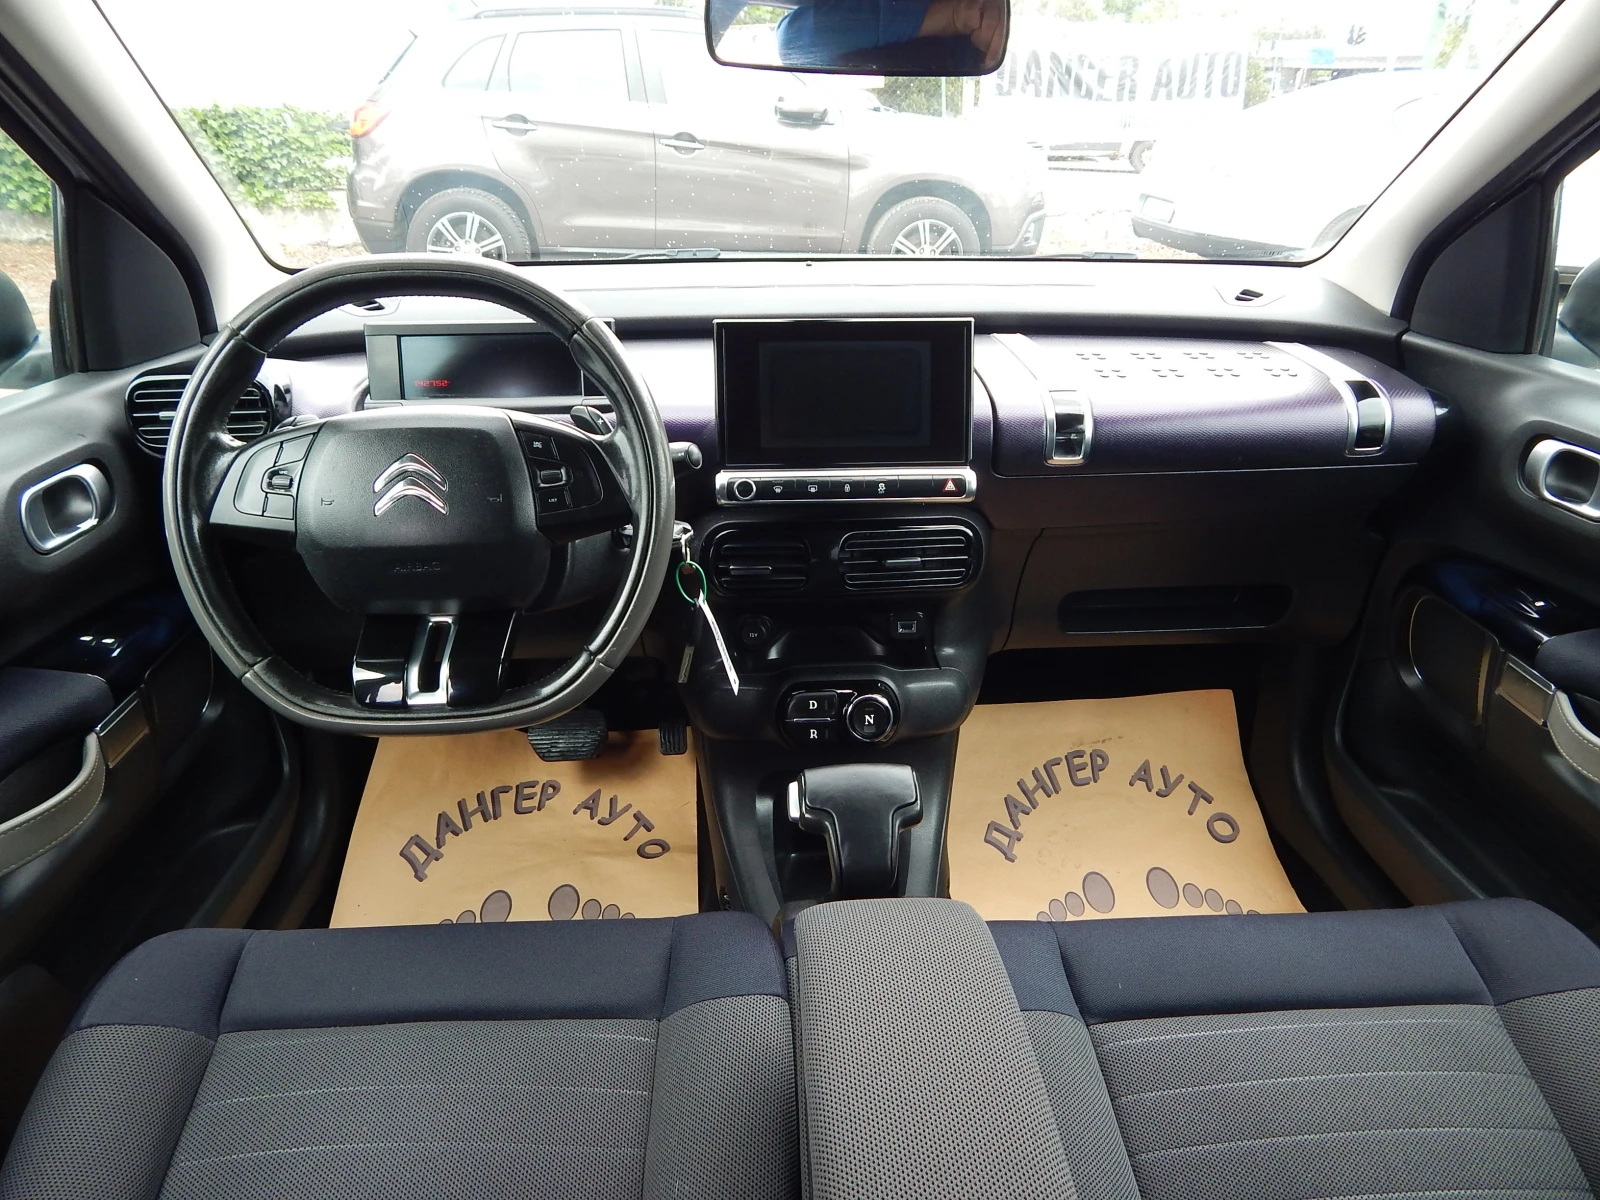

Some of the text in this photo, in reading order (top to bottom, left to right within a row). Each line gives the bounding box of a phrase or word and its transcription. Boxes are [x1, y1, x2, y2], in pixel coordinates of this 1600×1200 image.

[1150, 51, 1242, 101] AUTO
[808, 700, 818, 710] D
[864, 714, 875, 725] N
[809, 729, 818, 739] R
[983, 748, 1241, 863] ДАНГЕР АУТО
[399, 779, 671, 882] ДАНГЕР АУТО
